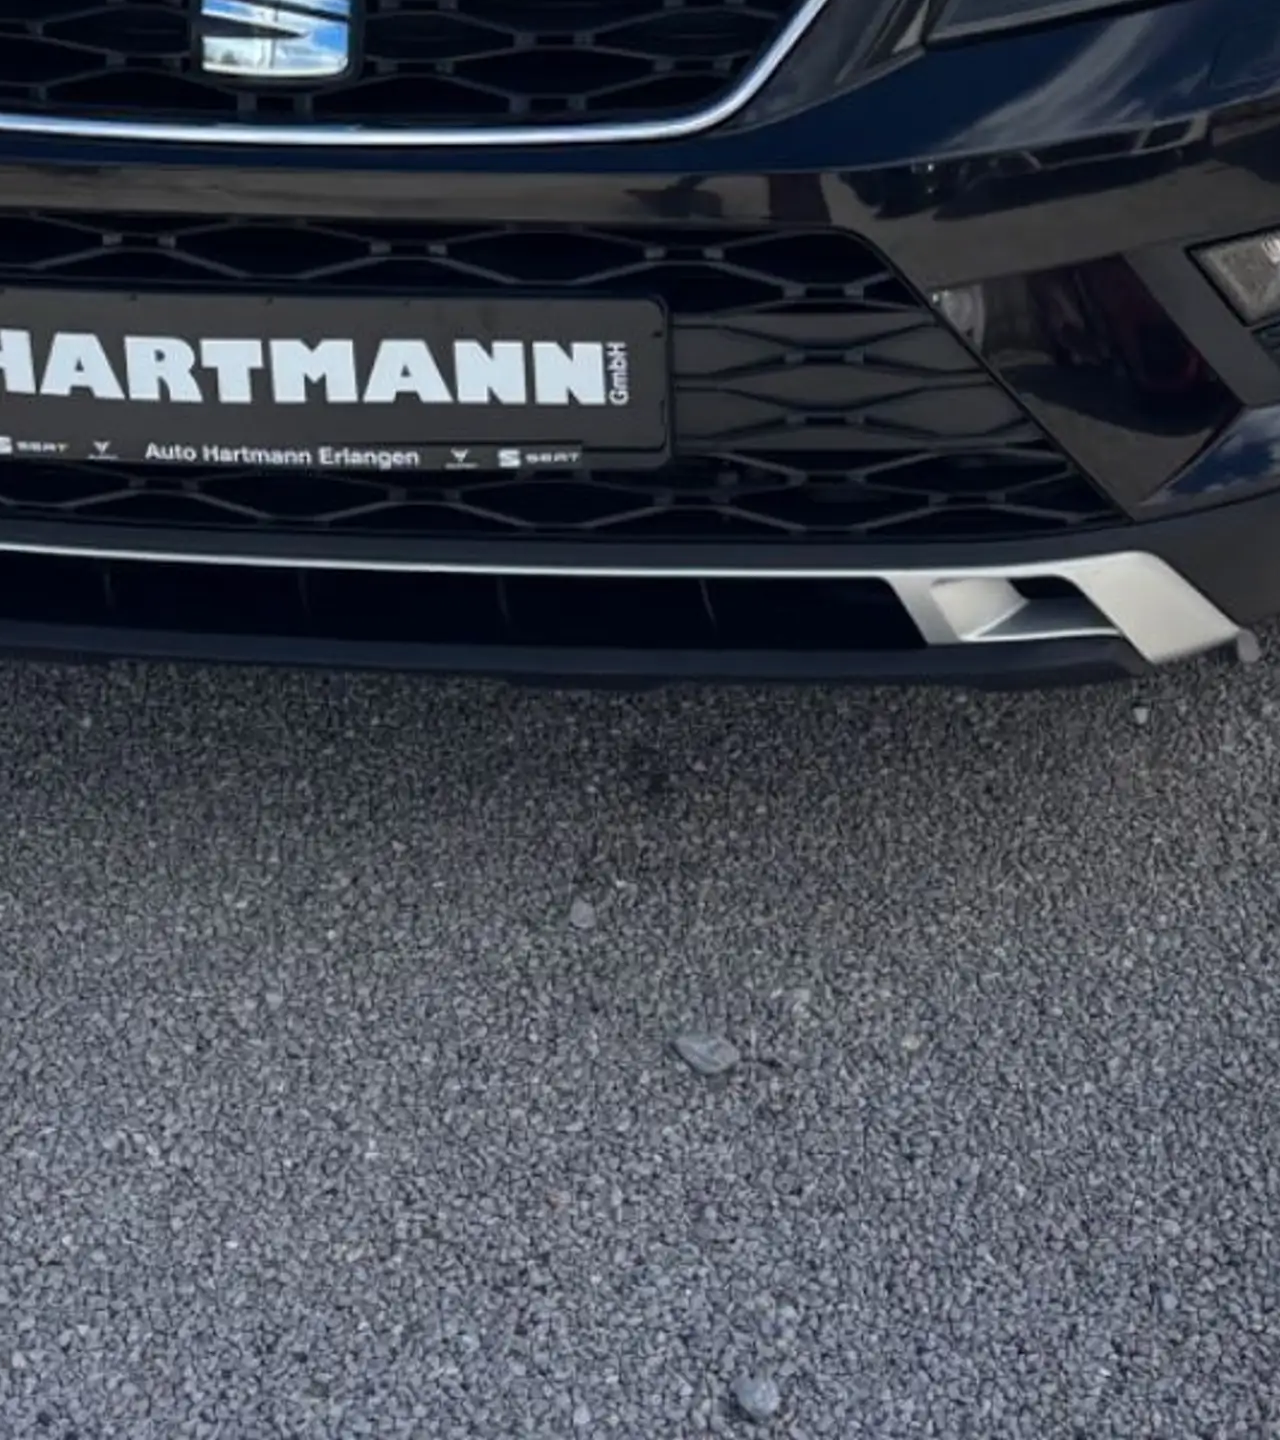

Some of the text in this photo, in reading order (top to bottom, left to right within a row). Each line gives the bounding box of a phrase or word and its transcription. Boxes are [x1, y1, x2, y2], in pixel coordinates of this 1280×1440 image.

[606, 341, 629, 406] GmbH
[145, 442, 420, 470] Auto Hartmann Erlangen
